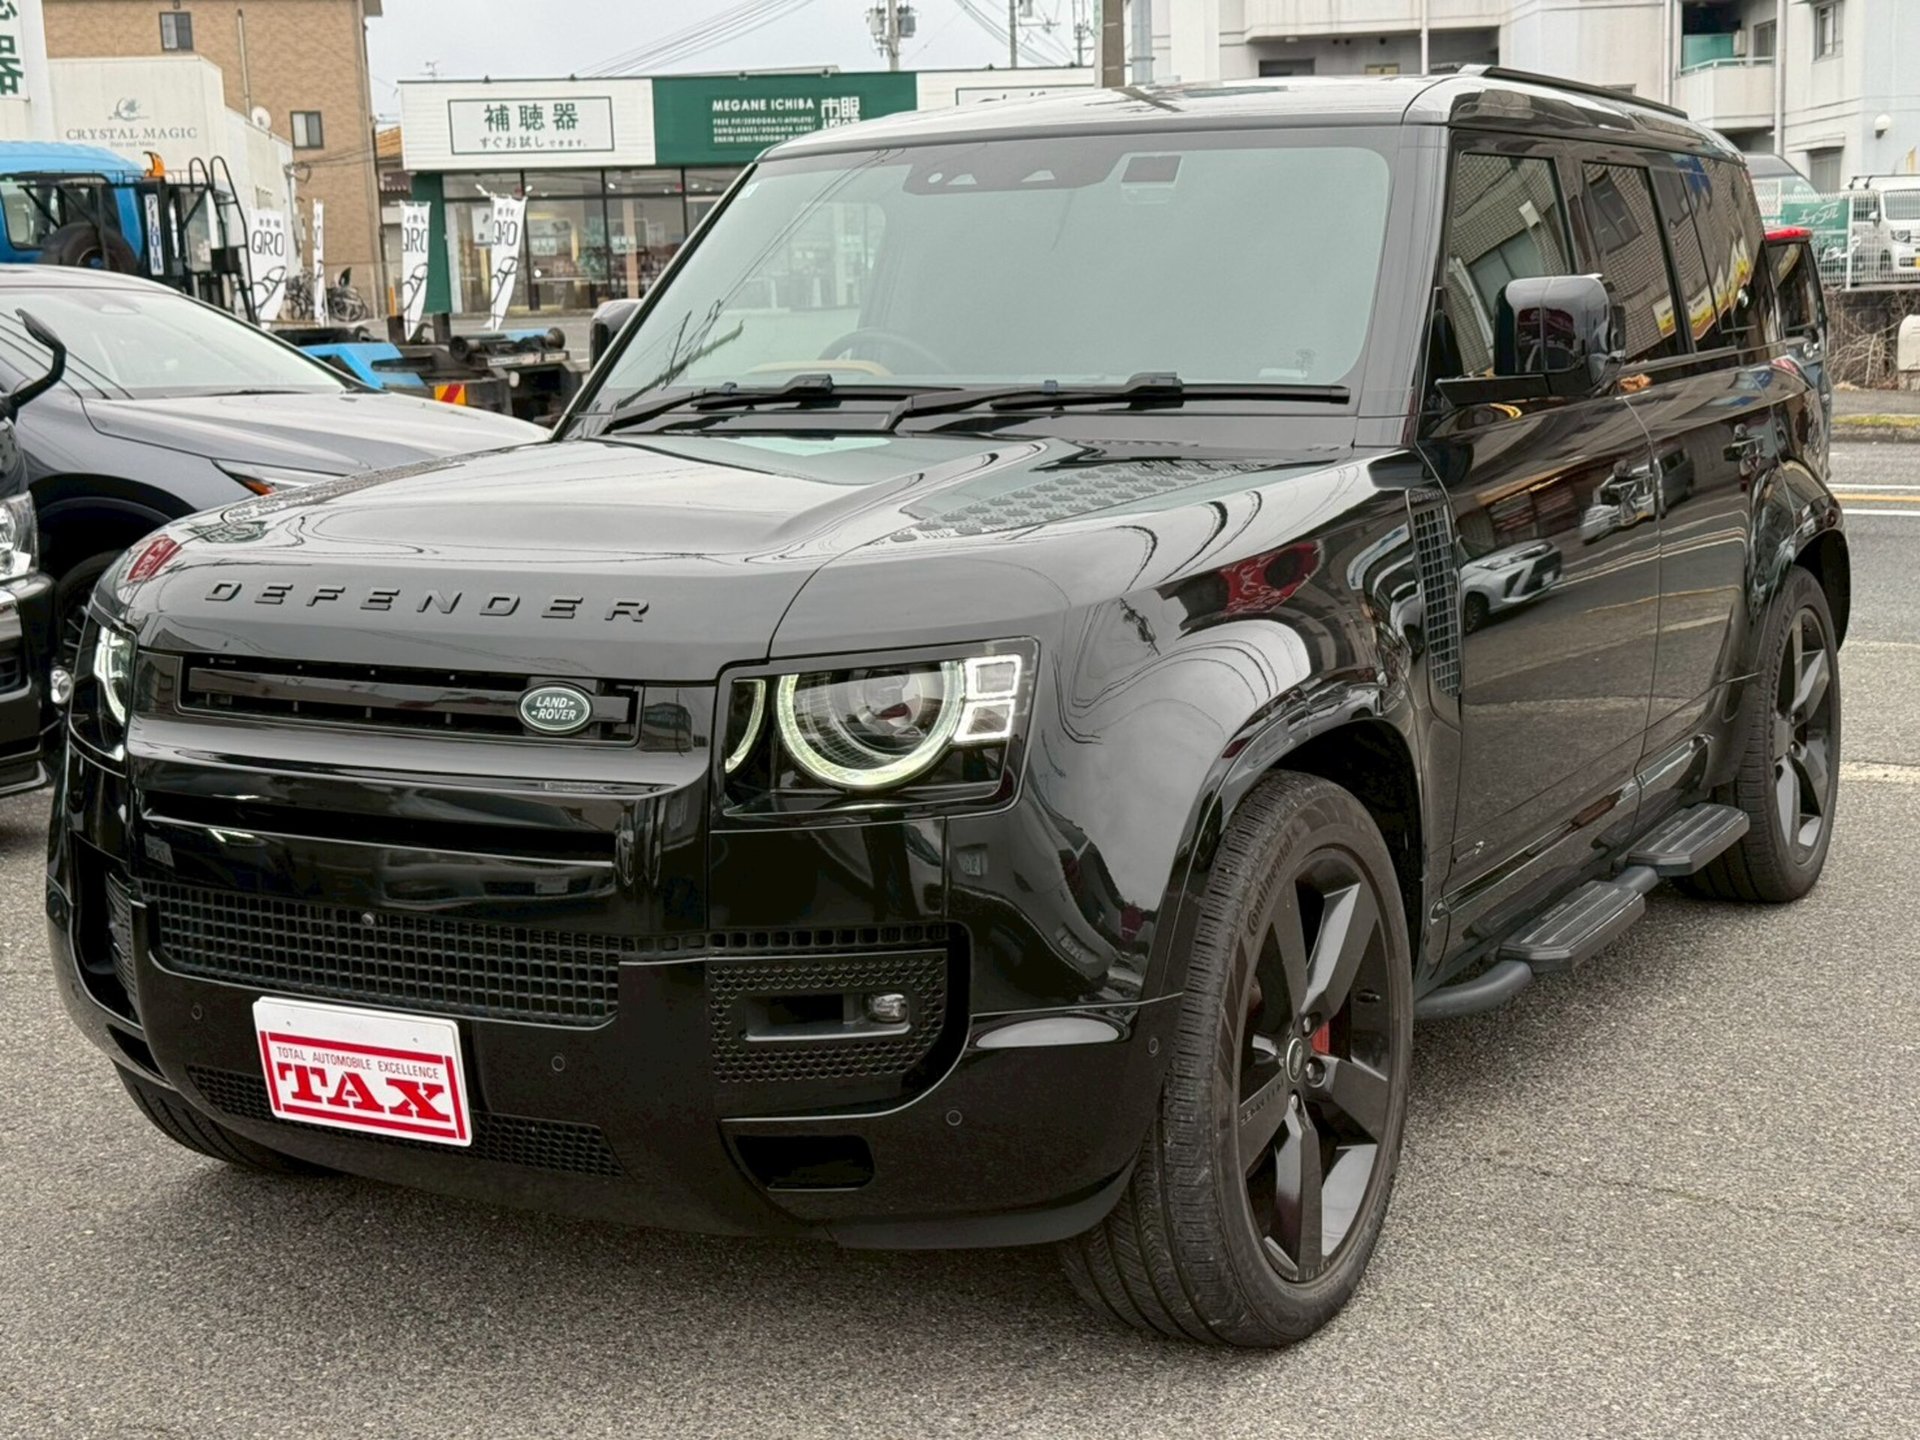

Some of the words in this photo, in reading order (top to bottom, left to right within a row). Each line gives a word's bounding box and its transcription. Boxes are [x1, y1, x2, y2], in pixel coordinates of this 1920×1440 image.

[484, 103, 579, 132] 補聴器
[712, 99, 767, 112] MEGANE
[770, 98, 815, 111] ICHIBA
[66, 128, 140, 141] CRYSTAL
[142, 127, 198, 140] MAGIC
[251, 230, 285, 257] QRO
[205, 580, 651, 623] DEFENDER
[535, 696, 568, 708] LAND
[537, 708, 577, 720] ROVER
[1247, 833, 1294, 937] Continental
[276, 1045, 306, 1061] TOTAL
[312, 1051, 371, 1071] AUTOMOBILE
[377, 1060, 439, 1079] EXCELLENCE
[277, 1062, 451, 1123] TAX
